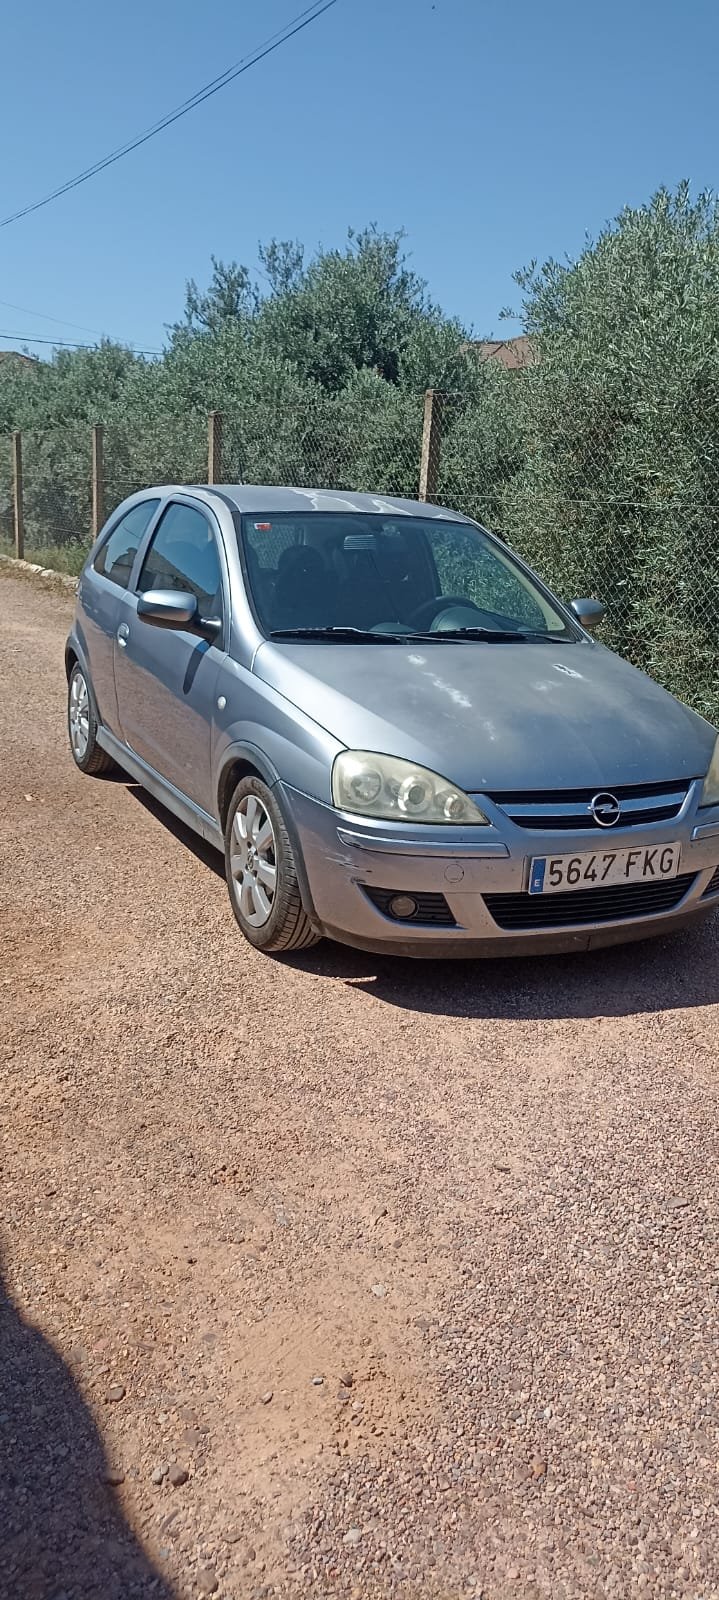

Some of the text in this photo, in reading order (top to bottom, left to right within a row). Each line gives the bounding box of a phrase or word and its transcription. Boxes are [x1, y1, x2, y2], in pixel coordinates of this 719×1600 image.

[550, 848, 674, 887] 5647 FKG
[534, 878, 541, 887] E
